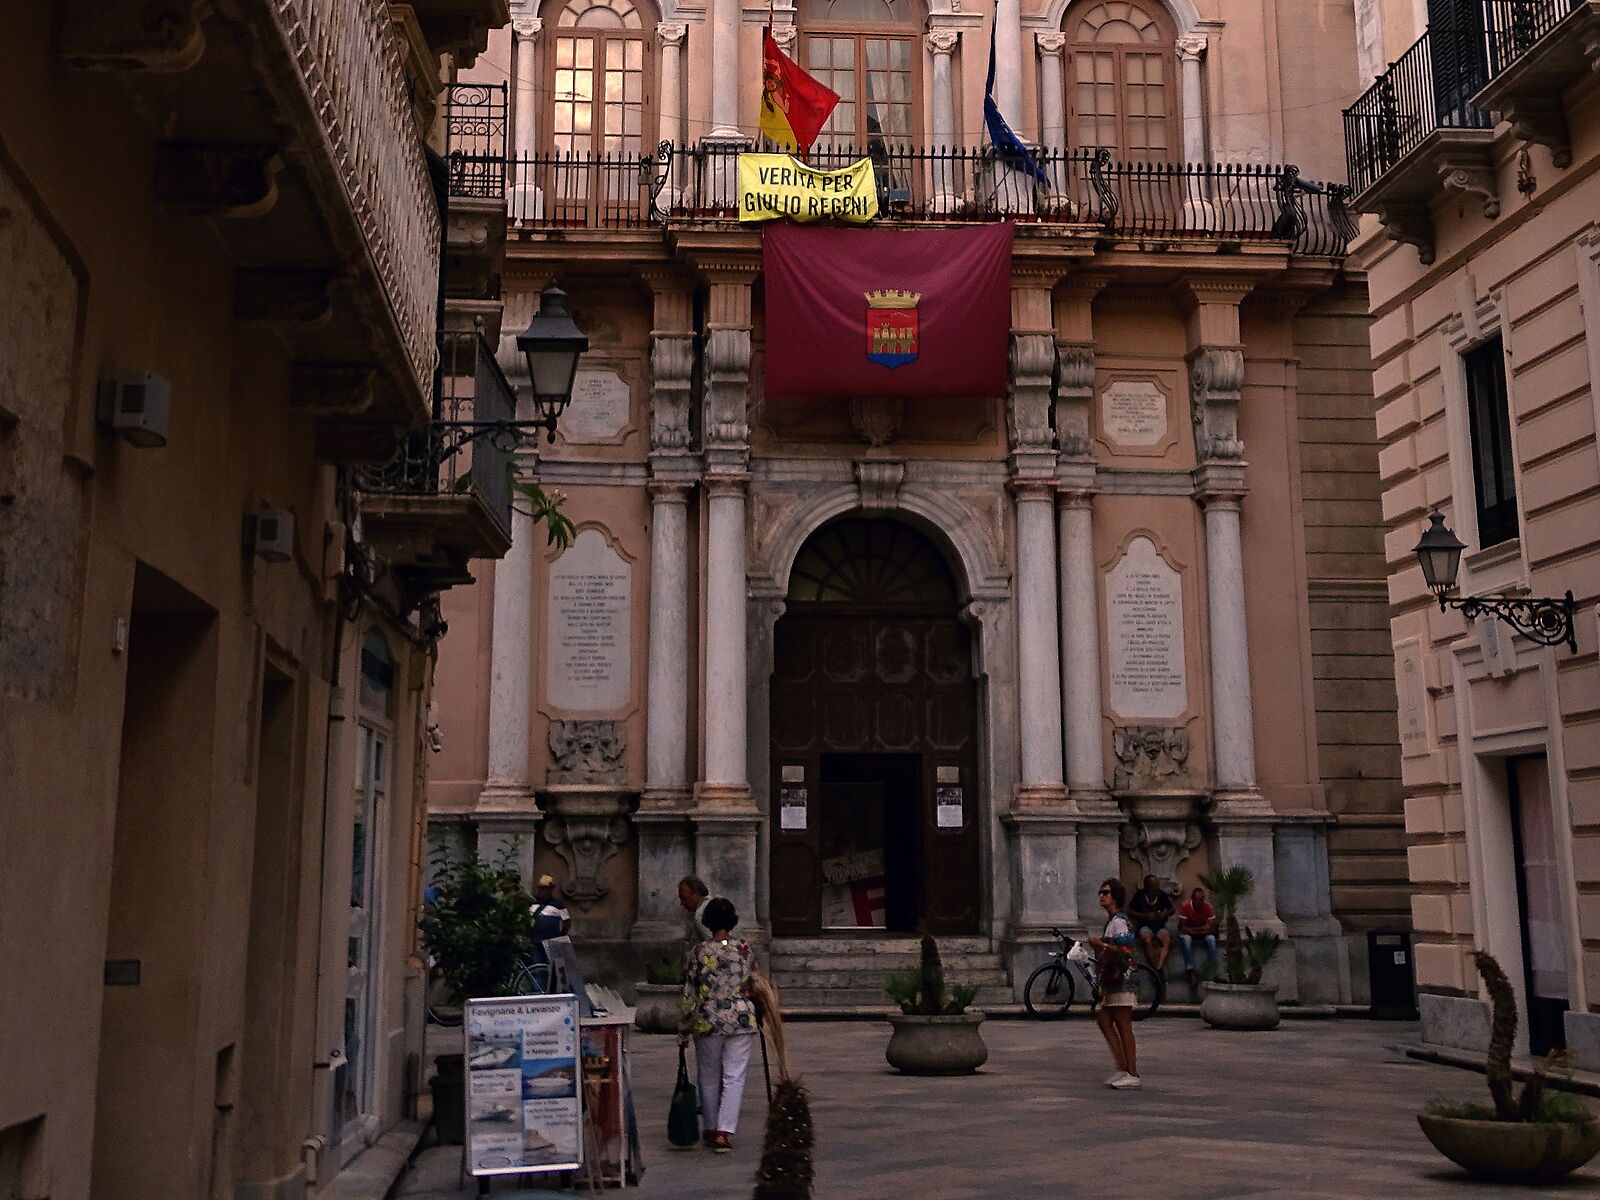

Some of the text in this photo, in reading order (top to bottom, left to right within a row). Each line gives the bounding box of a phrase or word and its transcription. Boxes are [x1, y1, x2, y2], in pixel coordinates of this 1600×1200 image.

[822, 174, 854, 193] PER
[744, 191, 868, 216] GIULIO REGENI
[472, 1004, 561, 1017] Favignana & Levanzo
